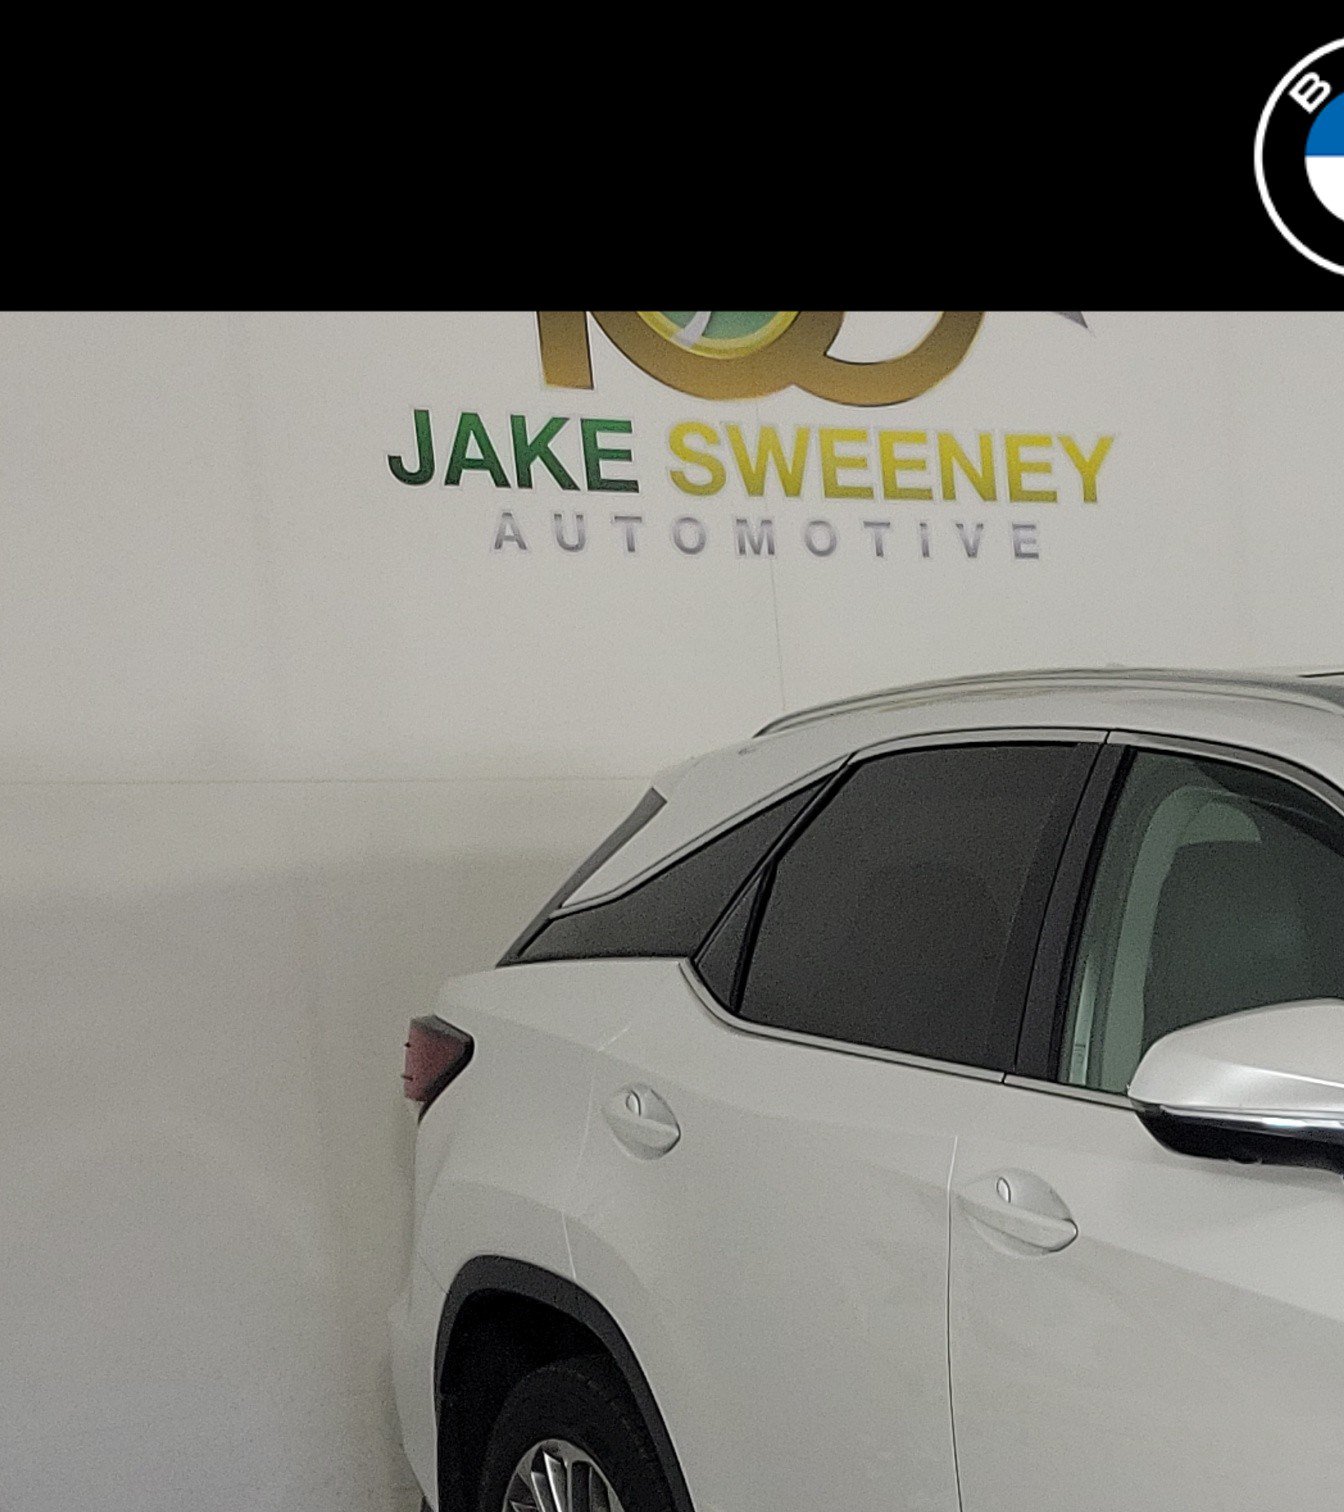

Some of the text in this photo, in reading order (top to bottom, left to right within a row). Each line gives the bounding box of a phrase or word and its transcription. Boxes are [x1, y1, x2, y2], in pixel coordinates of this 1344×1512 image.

[387, 408, 1115, 504] JAKE SWEENEY
[493, 511, 1041, 560] AUTOMOTIVE
